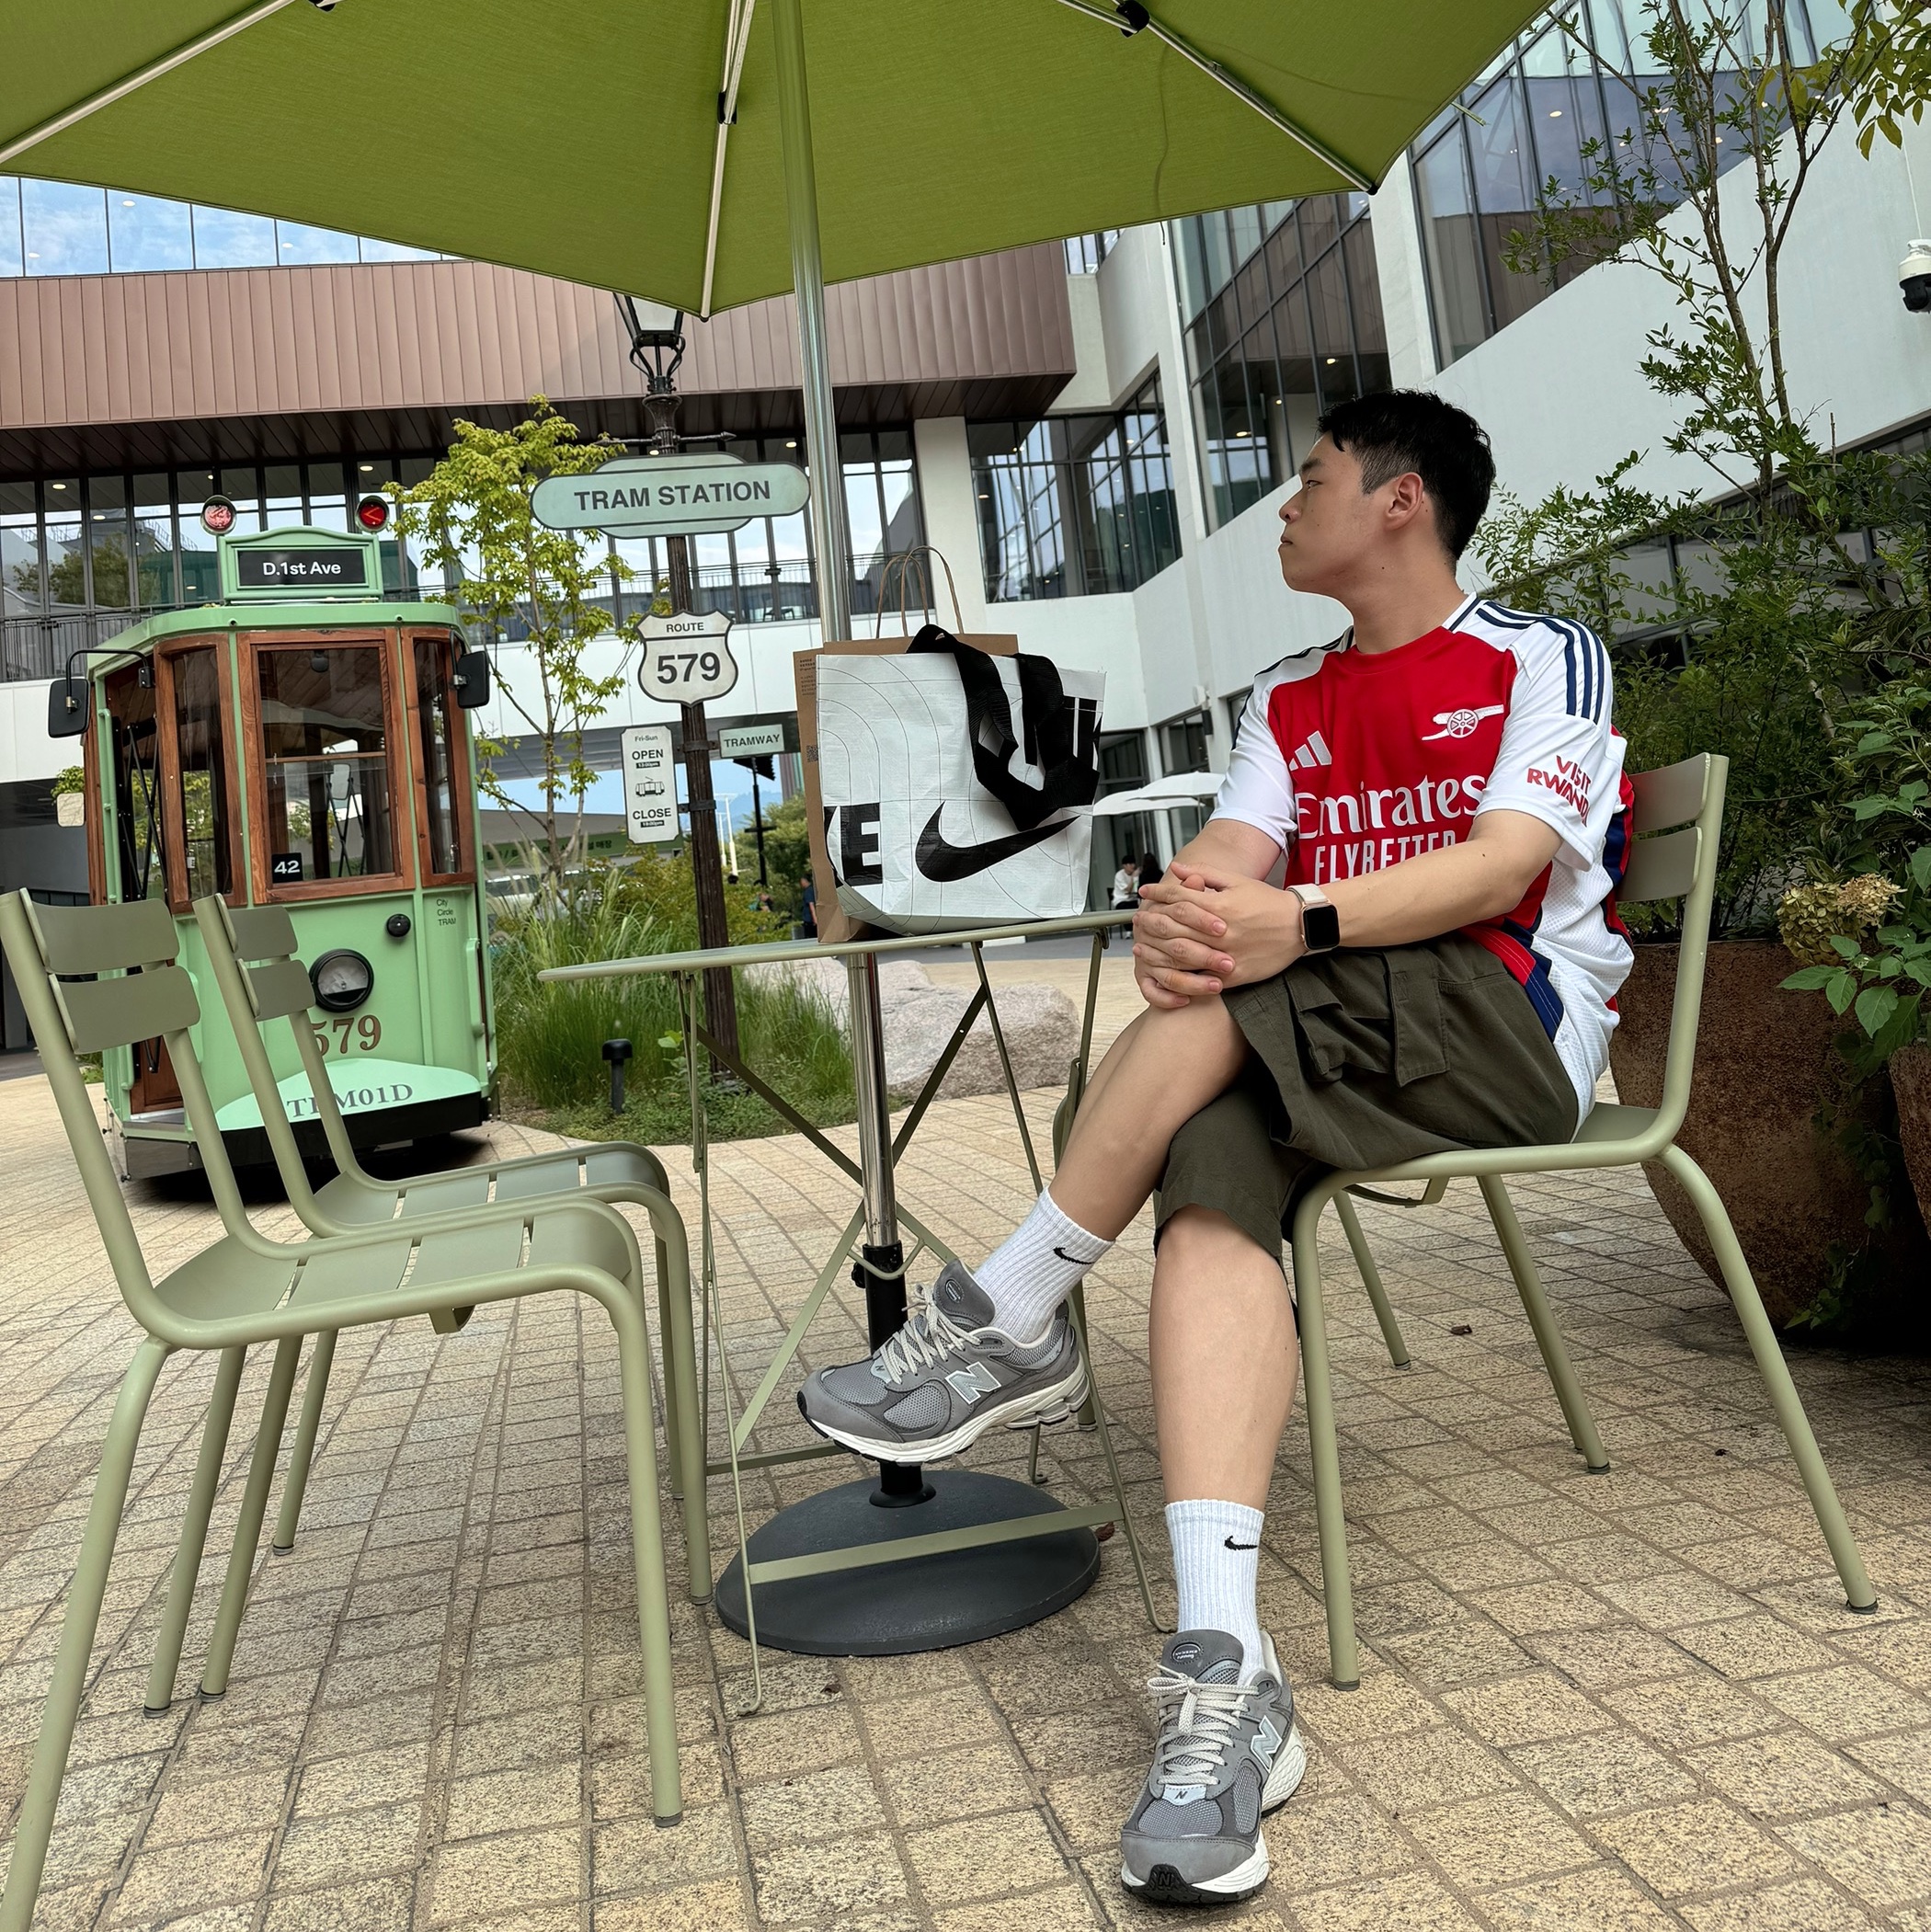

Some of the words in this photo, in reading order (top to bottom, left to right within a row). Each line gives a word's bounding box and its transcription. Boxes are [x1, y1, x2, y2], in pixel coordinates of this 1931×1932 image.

[574, 487, 649, 511] TRAM
[658, 480, 771, 506] STATION
[262, 561, 307, 576] D.1st
[310, 561, 341, 575] Ave
[666, 622, 704, 633] ROUTE
[657, 651, 721, 685] 579
[724, 733, 781, 748] TRAMWAY
[632, 749, 664, 760] OPEN
[1556, 755, 1592, 795] VISIT
[633, 807, 672, 820] CLOSE
[1295, 774, 1486, 840] Emirates
[274, 860, 301, 875] 42
[439, 917, 457, 926] TRAM
[287, 1083, 413, 1118] TM01D
[944, 1361, 1002, 1405] N
[1251, 1715, 1283, 1773] N
